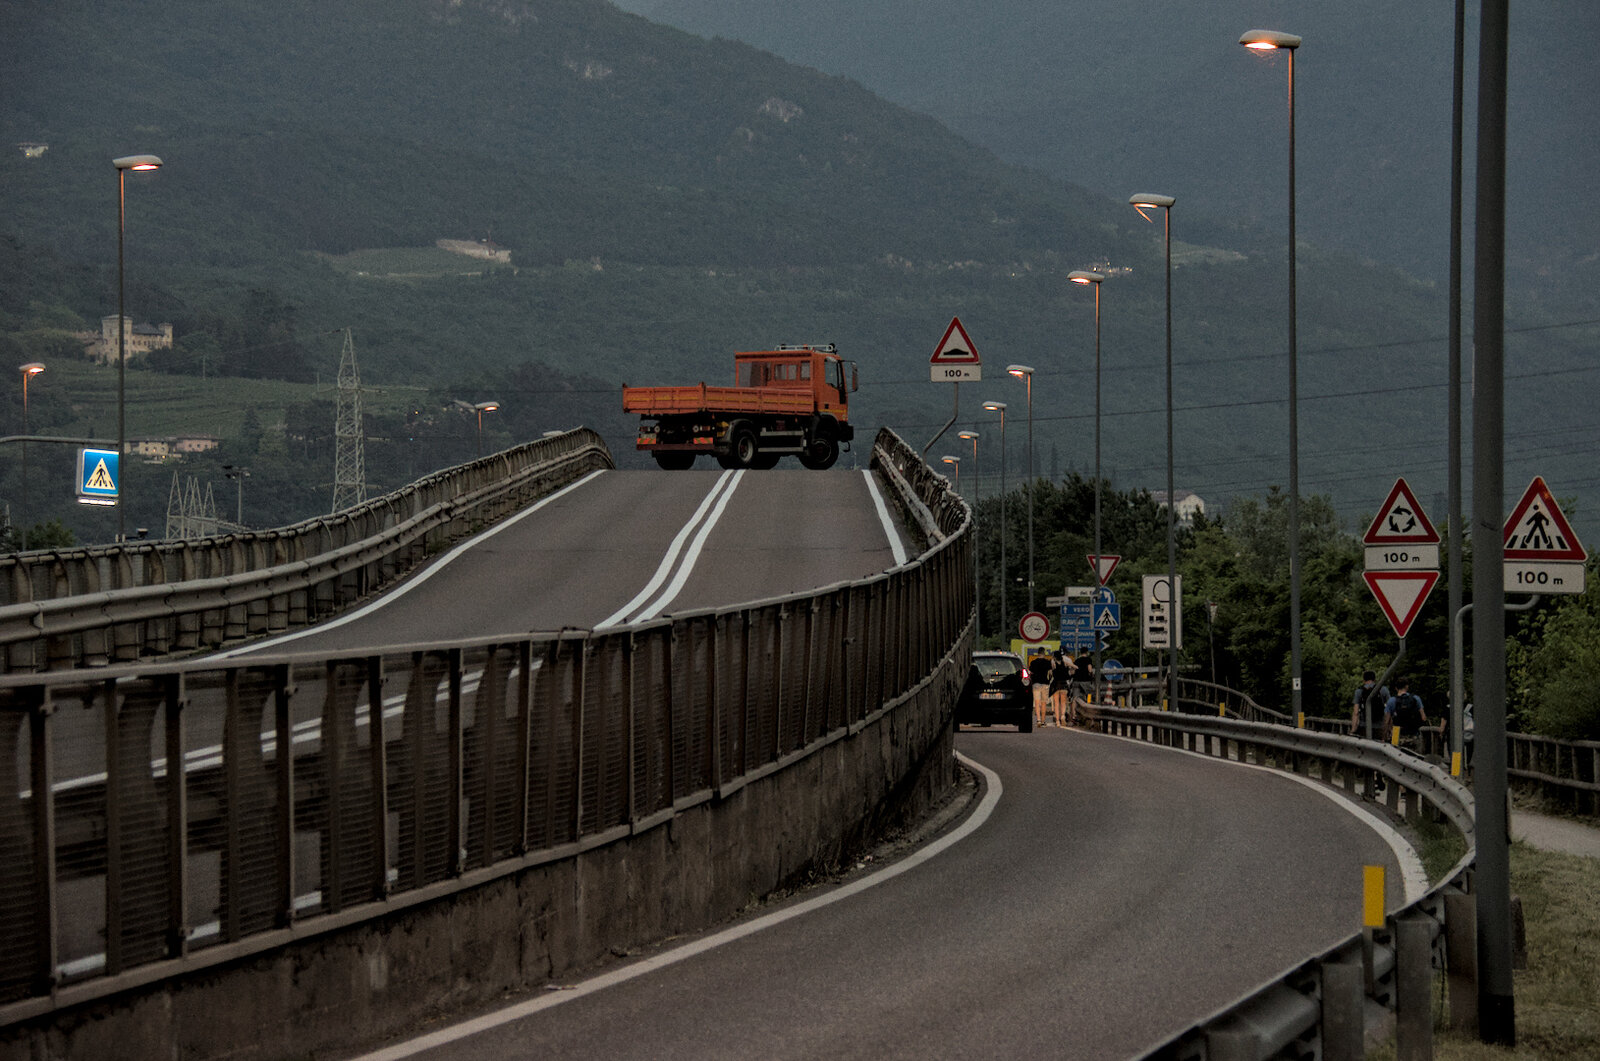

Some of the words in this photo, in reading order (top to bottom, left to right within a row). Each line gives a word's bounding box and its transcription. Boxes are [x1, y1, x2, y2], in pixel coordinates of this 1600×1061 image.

[1383, 552, 1409, 563] 100
[1412, 555, 1420, 563] m
[1516, 571, 1548, 585] 100
[1553, 576, 1564, 585] m
